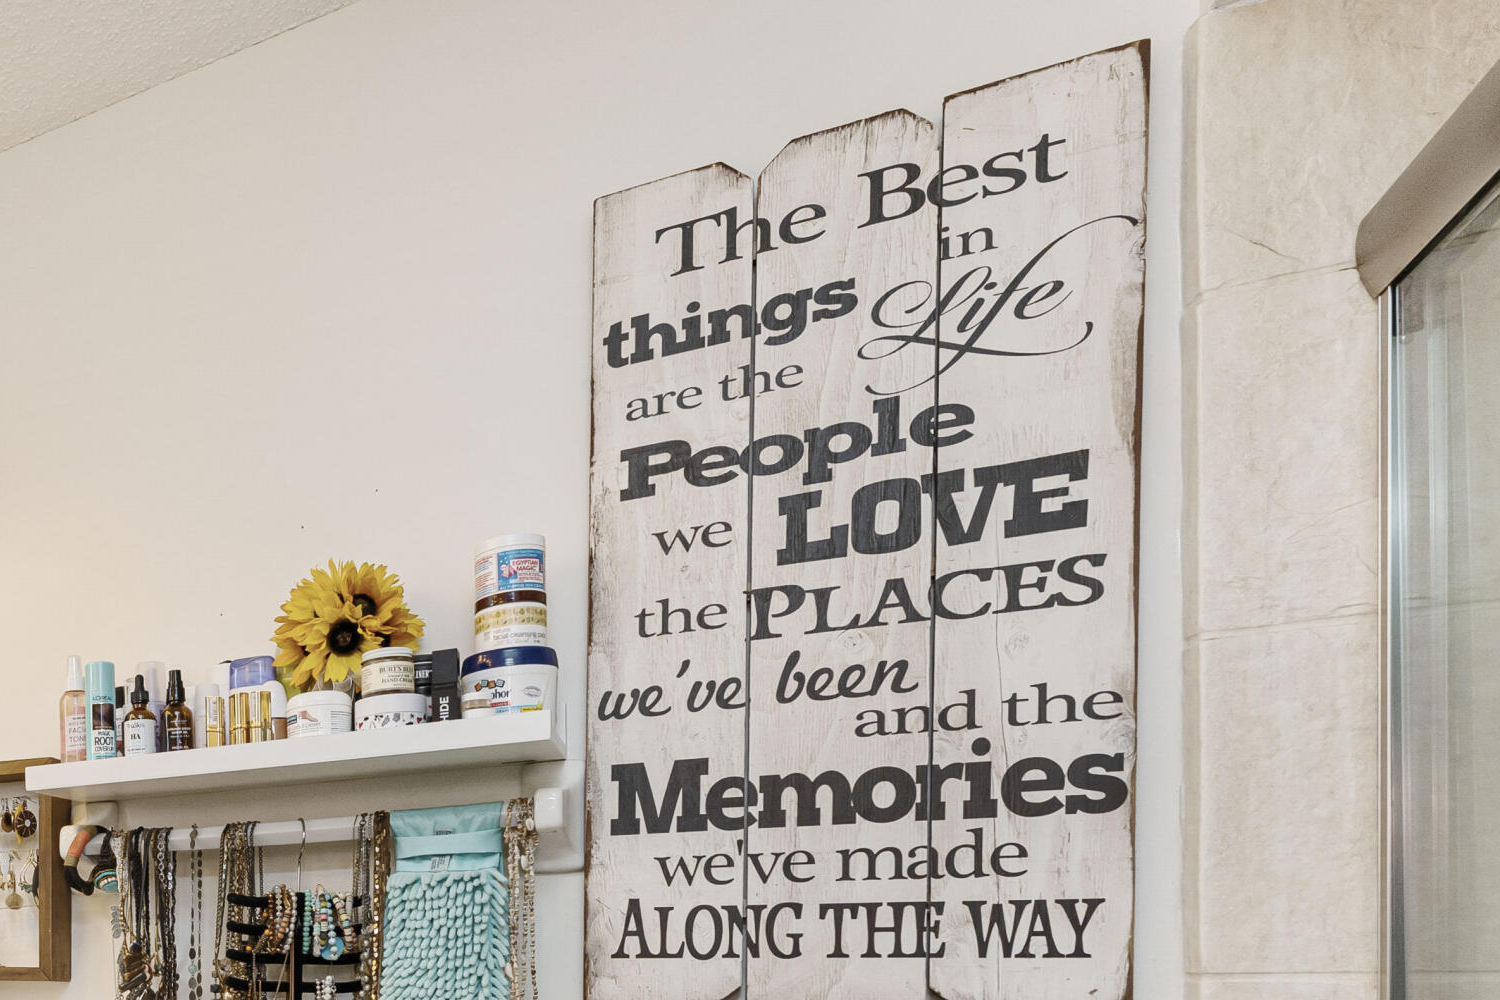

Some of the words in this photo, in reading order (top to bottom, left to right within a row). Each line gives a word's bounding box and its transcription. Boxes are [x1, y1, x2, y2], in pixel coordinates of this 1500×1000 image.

[655, 203, 826, 277] The
[856, 133, 1068, 229] Best
[940, 225, 998, 261] in
[603, 276, 858, 369] things
[857, 214, 1139, 396] Life
[626, 386, 703, 422] are
[718, 364, 804, 401] the
[619, 396, 975, 502] People
[652, 520, 733, 556] we
[776, 448, 1089, 566] LOVE
[634, 600, 729, 638] the
[744, 553, 1107, 641] PLACES
[598, 659, 748, 721] we've
[775, 650, 918, 704] been
[854, 689, 983, 738] and
[1001, 683, 1124, 727] the
[94, 737, 114, 746] ROOT
[610, 737, 1129, 836] Memories
[655, 839, 816, 887] we've
[835, 828, 1029, 882] made
[612, 898, 803, 961] ALONG
[819, 900, 947, 960] THE
[963, 898, 1106, 960] WAY
